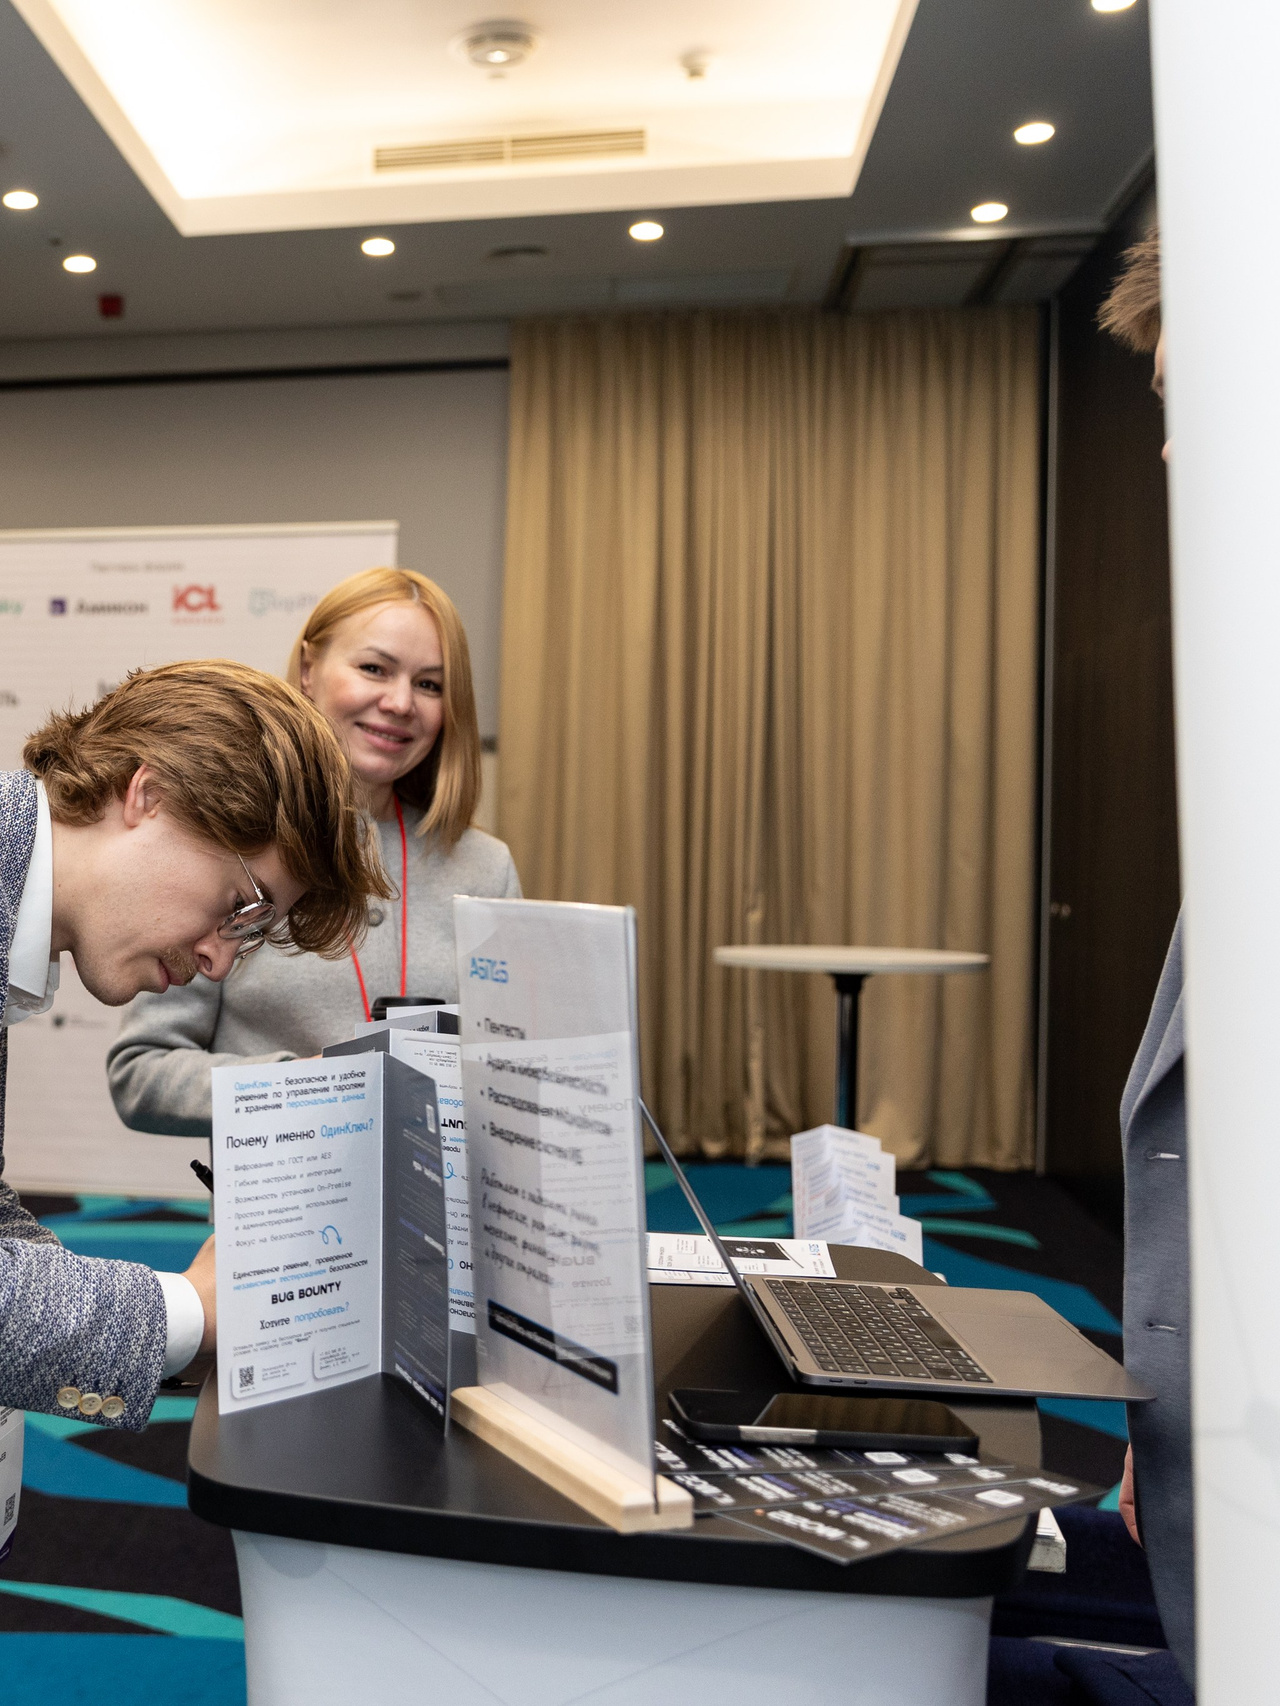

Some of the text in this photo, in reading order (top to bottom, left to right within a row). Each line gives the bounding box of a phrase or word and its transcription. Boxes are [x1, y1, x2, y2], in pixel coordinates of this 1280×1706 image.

[285, 1075, 327, 1085] безопасное
[339, 1070, 366, 1082] удобное
[235, 1093, 268, 1104] решение
[334, 1082, 365, 1092] паролями
[245, 1103, 282, 1114] хранение
[287, 1097, 338, 1108] персональных
[342, 1093, 365, 1103] данных
[226, 1118, 373, 1149] Почему именно ОдинКлюч?
[234, 1162, 274, 1172] Шифрование
[289, 1156, 303, 1164] ГОСТ
[321, 1152, 332, 1160] AES
[234, 1180, 259, 1188] Гибкие
[262, 1174, 296, 1184] настройки
[307, 1168, 342, 1178] интеграции
[235, 1181, 351, 1204] Возможность установки On-Premise
[234, 1211, 264, 1220] Простота
[306, 1196, 348, 1209] использования
[242, 1216, 303, 1230] администрирования
[236, 1239, 256, 1247] Фокус
[270, 1229, 314, 1241] безопасность
[233, 1266, 280, 1280] Единственное
[315, 1252, 353, 1265] проверенное
[233, 1278, 276, 1290] независимым
[329, 1259, 368, 1272] безопасности
[271, 1281, 341, 1304] BUG BOUNTY
[260, 1301, 350, 1330] Хотите попробовать?
